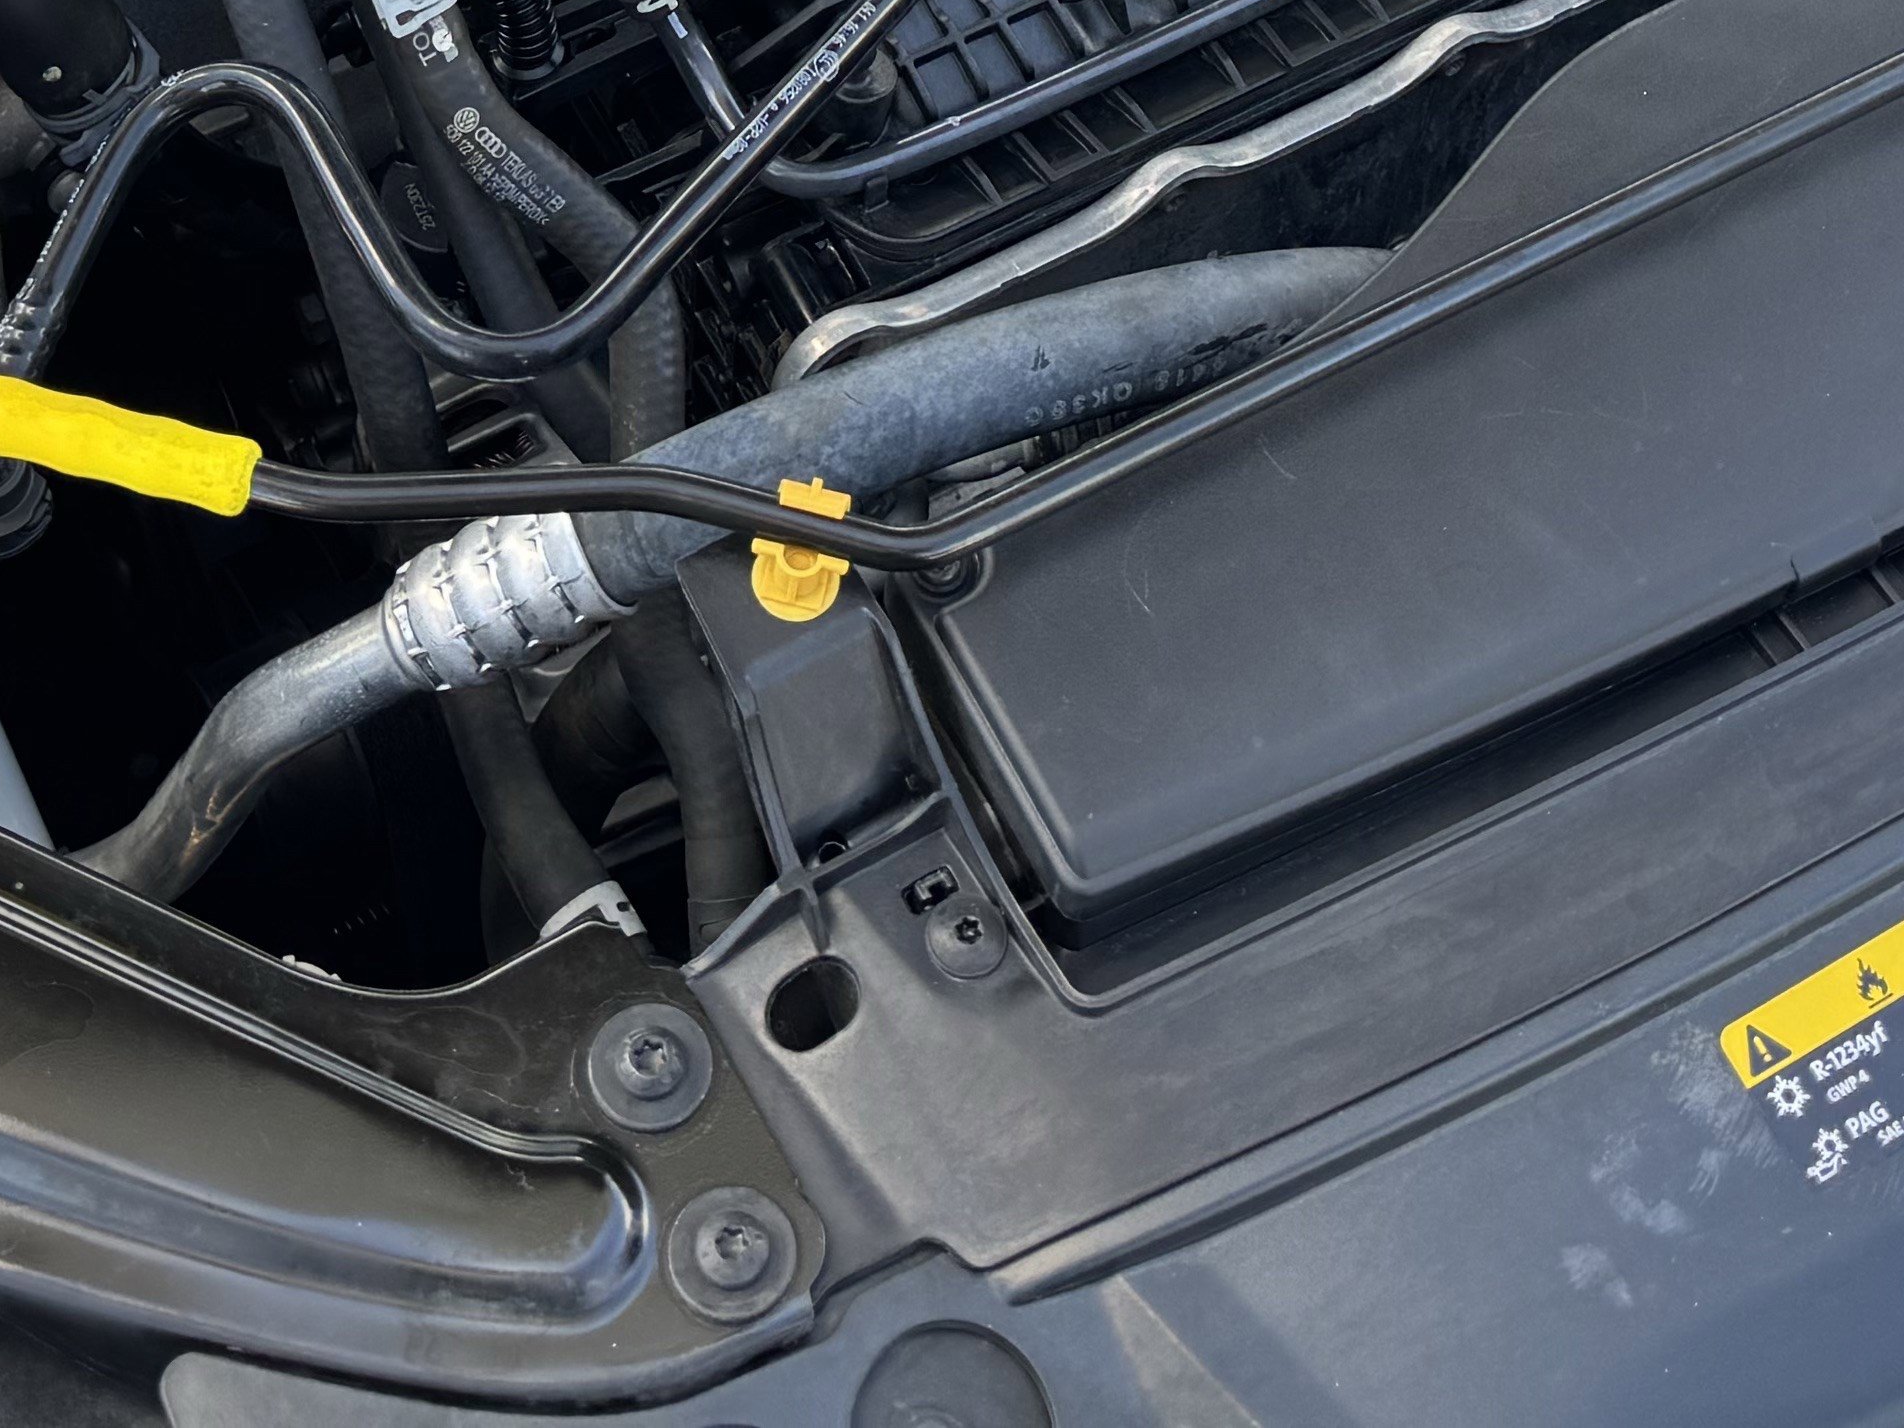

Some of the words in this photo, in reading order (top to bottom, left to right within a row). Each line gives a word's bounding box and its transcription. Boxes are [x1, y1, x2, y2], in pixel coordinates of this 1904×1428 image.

[498, 150, 539, 189] TEKLAS
[1806, 1020, 1894, 1085] R-1234yf
[1824, 1075, 1861, 1103] GWP
[1856, 1068, 1871, 1084] 4
[1842, 1100, 1892, 1139] PAG
